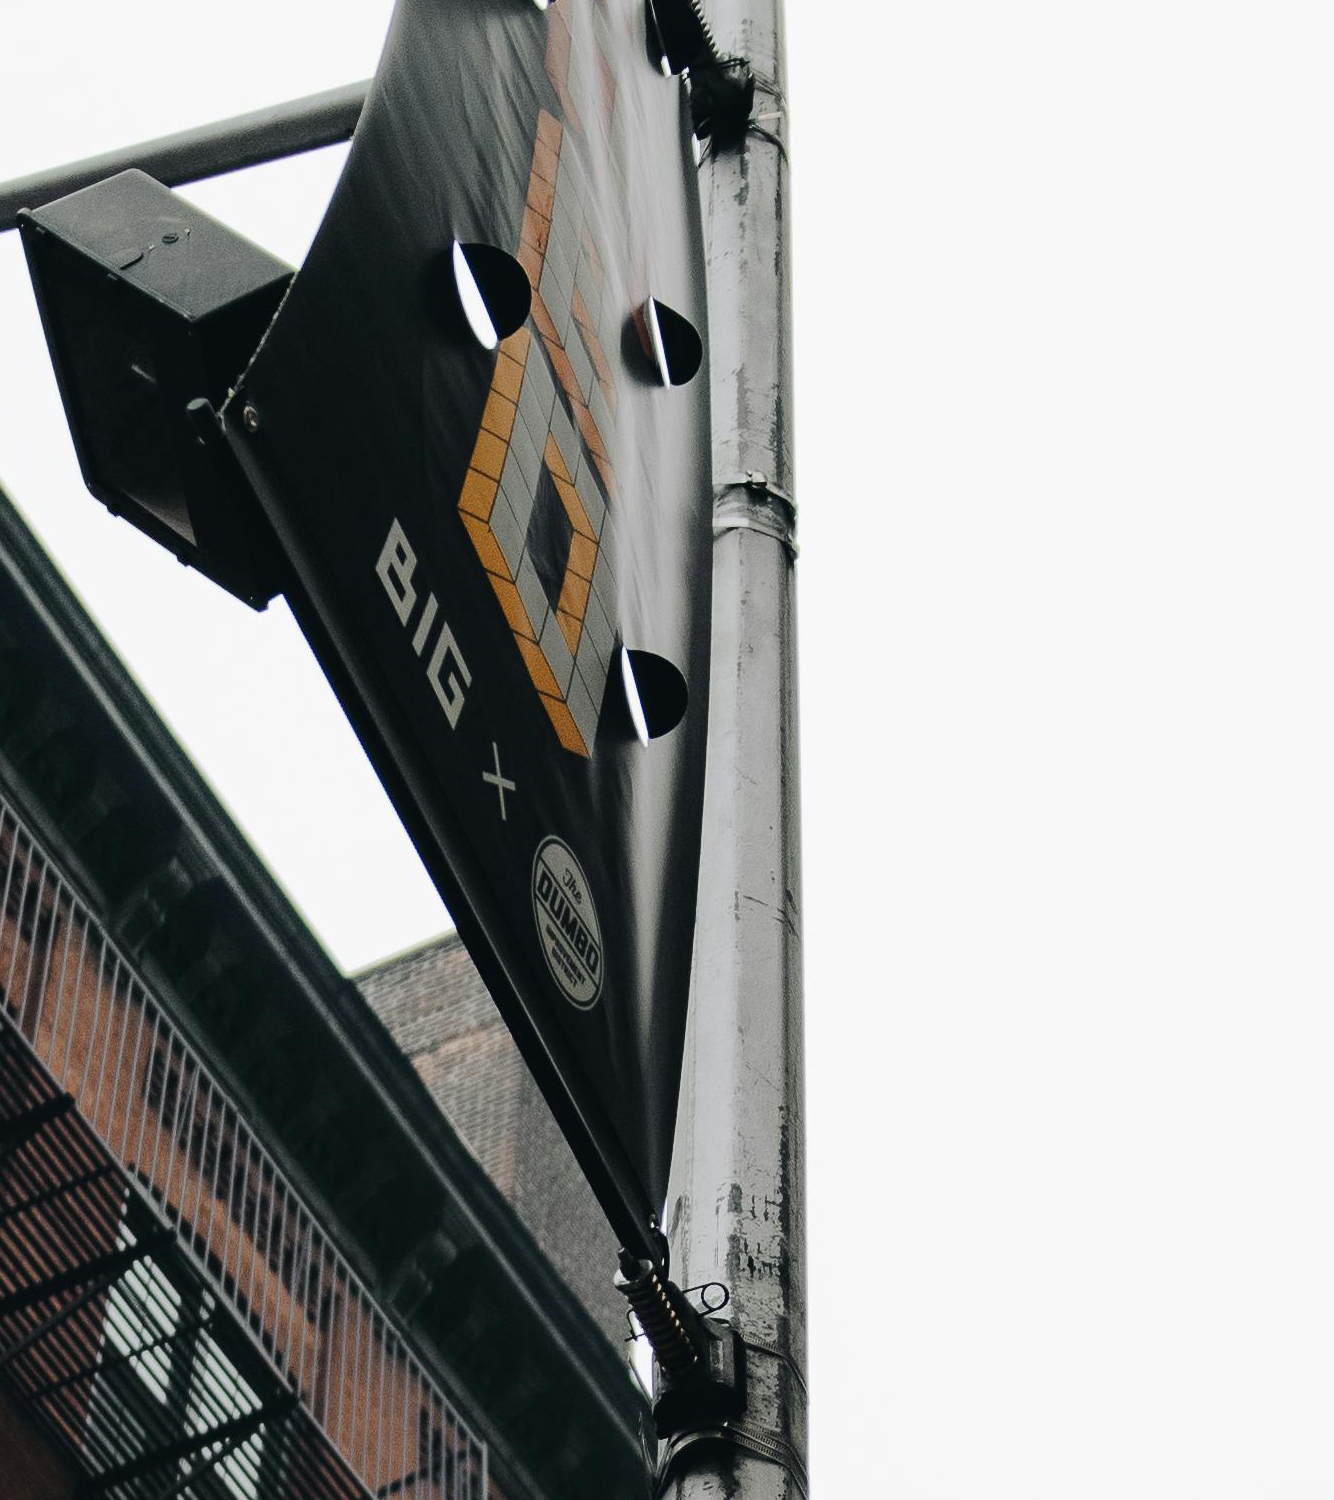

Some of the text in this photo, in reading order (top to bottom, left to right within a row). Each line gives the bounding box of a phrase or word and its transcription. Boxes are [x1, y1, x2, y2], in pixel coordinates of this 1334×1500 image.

[375, 517, 473, 731] BIG
[537, 868, 599, 975] DUMBO
[562, 867, 582, 905] The
